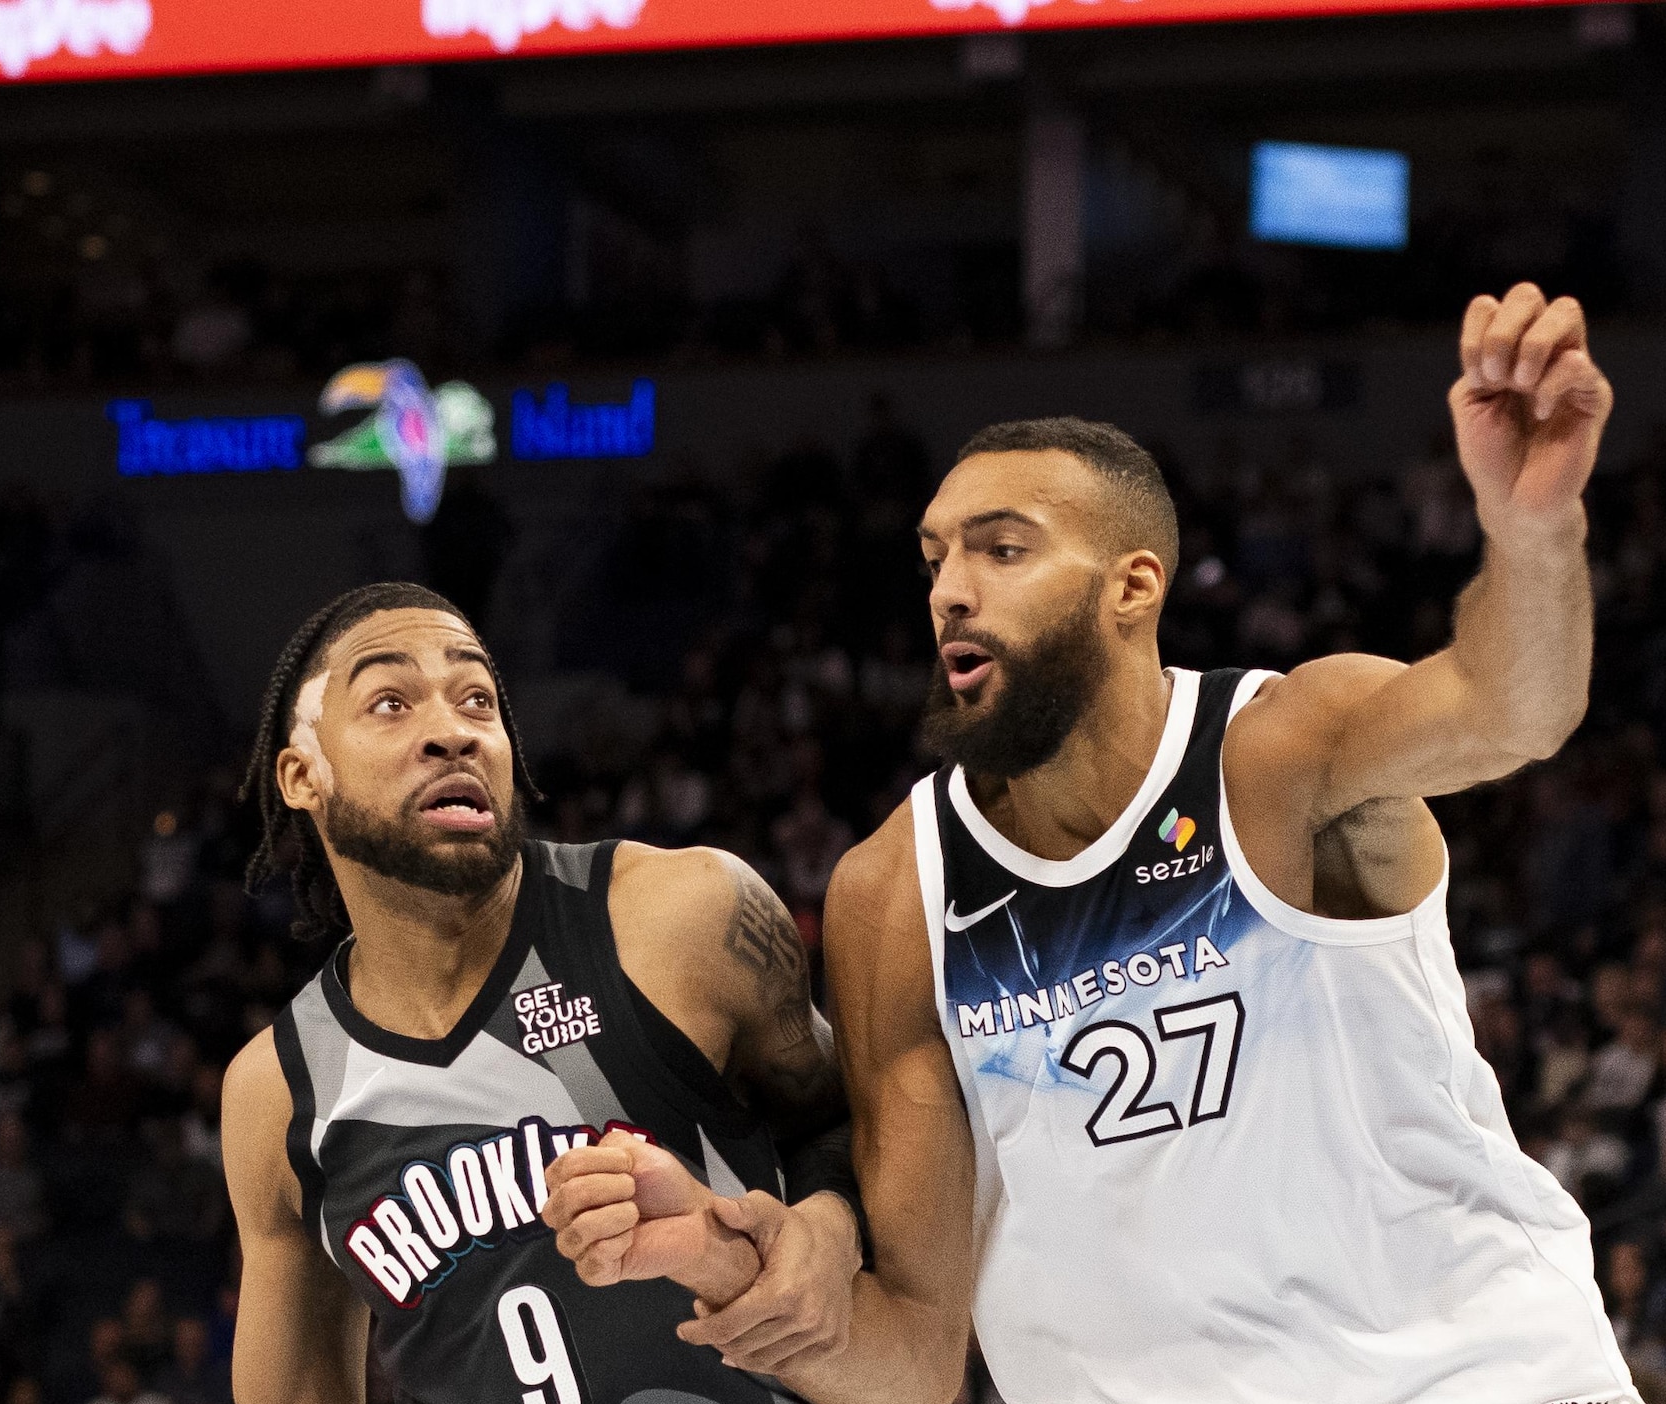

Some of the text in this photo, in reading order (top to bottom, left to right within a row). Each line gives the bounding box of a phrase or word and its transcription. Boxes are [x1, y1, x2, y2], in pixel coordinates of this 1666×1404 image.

[1135, 845, 1214, 884] sezzle
[515, 983, 563, 1013] GET
[957, 935, 1229, 1038] MINNESOTA
[518, 996, 593, 1032] YOUR
[523, 1014, 601, 1054] GUIDE
[1060, 992, 1246, 1148] 27
[349, 1123, 648, 1303] BROOKL
